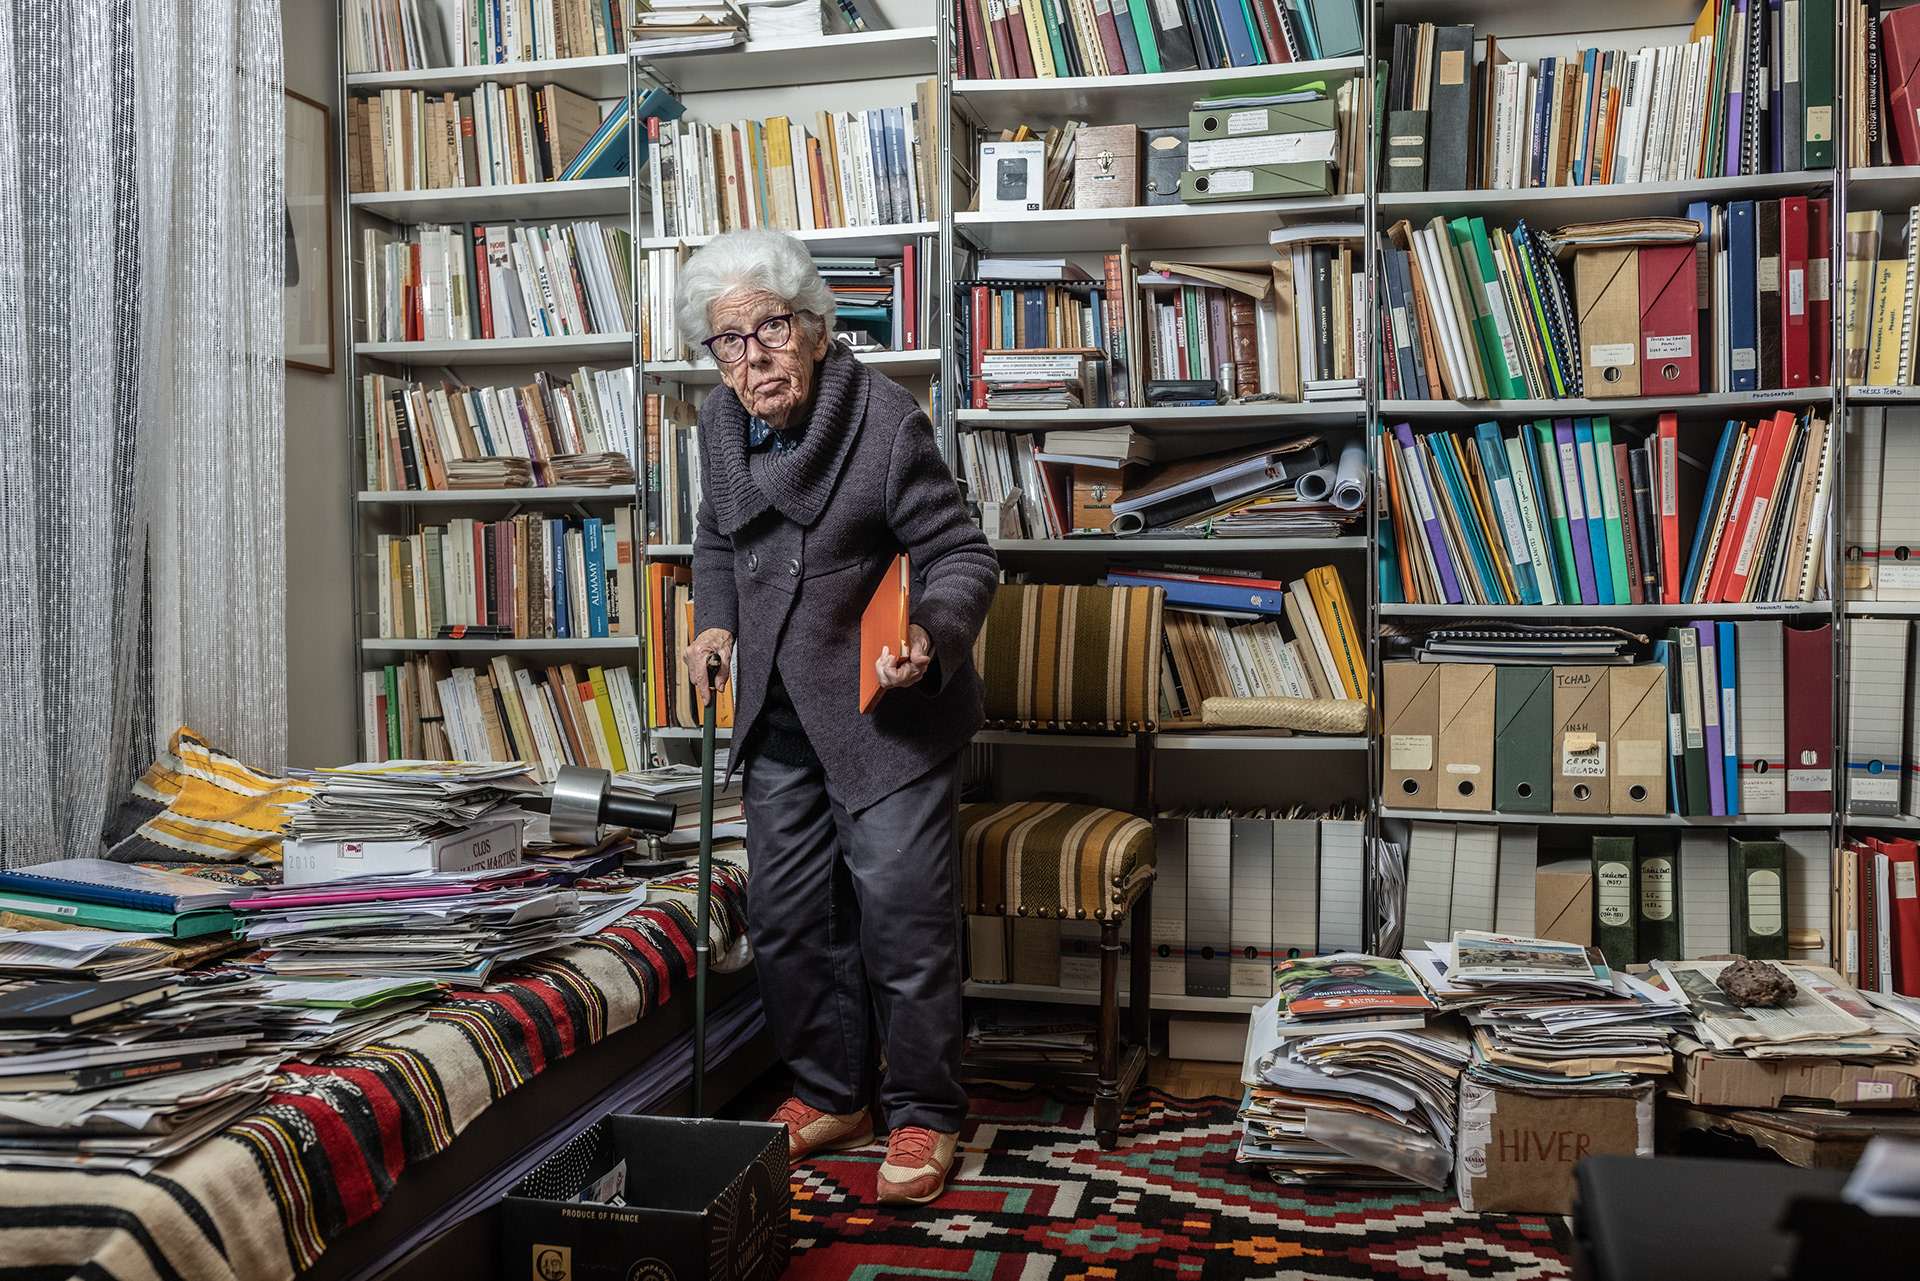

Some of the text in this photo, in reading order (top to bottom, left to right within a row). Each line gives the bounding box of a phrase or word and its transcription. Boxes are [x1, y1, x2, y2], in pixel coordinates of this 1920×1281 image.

[1868, 108, 1877, 142] CONFORT
[489, 241, 506, 249] NOIR
[578, 392, 586, 409] parole
[583, 416, 592, 434] graines
[554, 546, 564, 574] femmes
[588, 561, 600, 606] ALMAMY
[1257, 626, 1283, 683] PAYSANS AFRICAINS
[1556, 673, 1592, 686] TCHAD
[1291, 682, 1300, 697] FASO
[632, 725, 641, 747] TCHAD
[1566, 723, 1589, 732] INSH
[1566, 757, 1600, 766] CEFOD
[472, 839, 491, 858] CLOS
[288, 855, 316, 870] 2016
[486, 847, 516, 870] MARTINS
[1498, 1128, 1591, 1163] HIVER
[561, 1208, 640, 1224] PRODUCE OF FRANCE
[632, 1264, 670, 1281] CHAMPAGN
